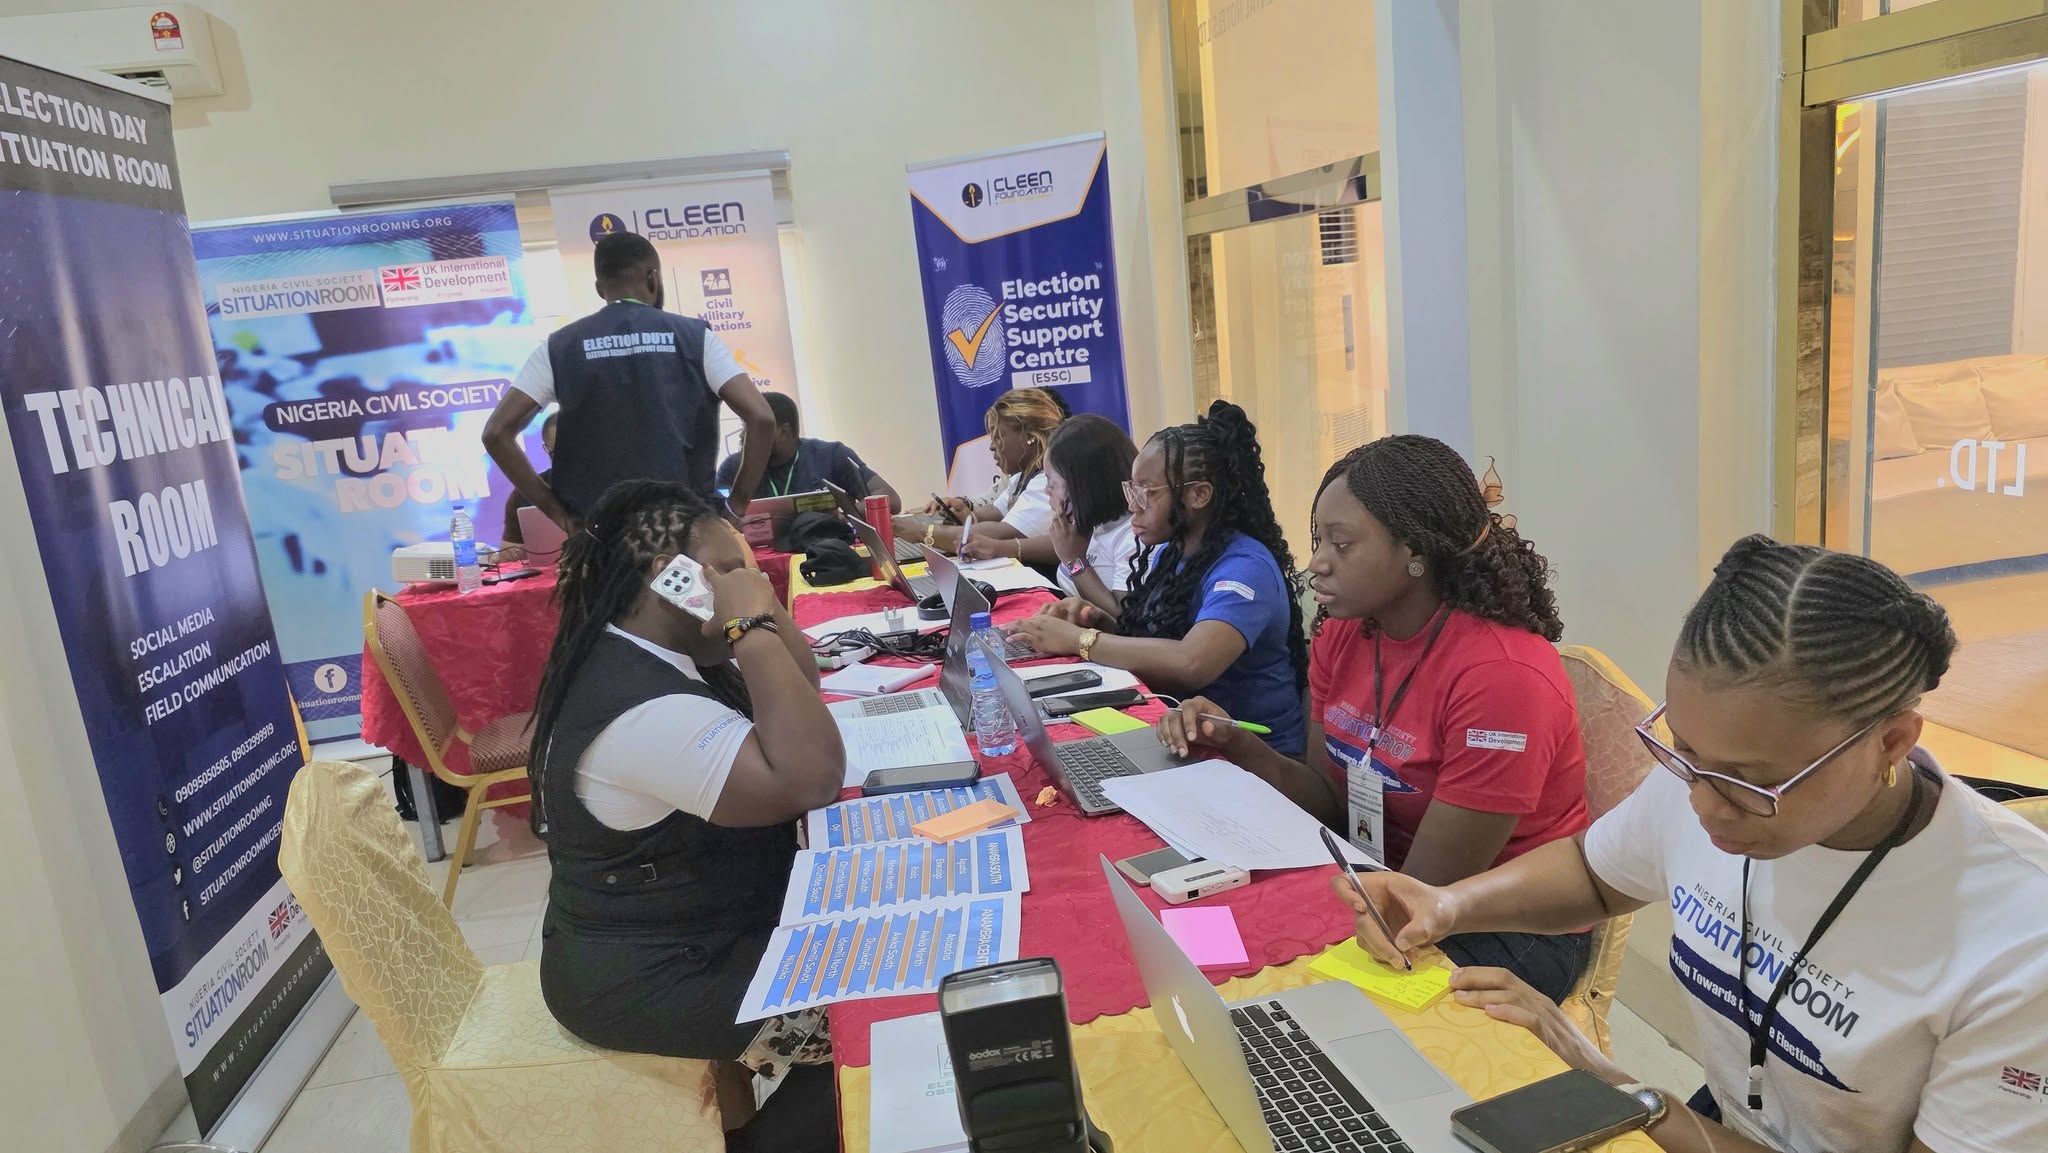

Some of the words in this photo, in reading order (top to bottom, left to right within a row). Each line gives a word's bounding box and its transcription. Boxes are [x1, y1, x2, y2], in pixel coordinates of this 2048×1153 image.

[0, 82, 106, 136] LECTION
[108, 110, 148, 145] DAY
[0, 131, 111, 180] ITUATION
[113, 154, 172, 190] ROOM
[993, 170, 1053, 192] CLEEN
[645, 201, 745, 229] CLEEN
[252, 216, 453, 245] WWW.SITUATIONROOMNG.ORG
[647, 223, 746, 241] FOUNDATION
[422, 264, 439, 275] UK
[440, 259, 506, 273] International
[424, 271, 508, 289] Development
[232, 282, 278, 295] NIGERIA
[282, 278, 312, 290] CIVIL
[316, 274, 364, 287] SOCIETY
[1001, 271, 1100, 300] Election
[222, 284, 377, 315] SITUATIONROOM
[706, 298, 733, 310] Civil
[1004, 294, 1104, 324] Security
[697, 310, 745, 321] Military
[710, 320, 752, 332] lations
[583, 332, 640, 352] ELECTION
[641, 332, 675, 345] DUTY
[1006, 319, 1105, 348] Support
[1009, 347, 1090, 370] Centre
[1031, 369, 1072, 386] (ESSC)
[276, 399, 365, 425] NIGERIA
[365, 393, 418, 415] CIVIL
[418, 383, 505, 409] SOCIETY
[24, 375, 232, 475] TECHNICAL
[335, 462, 491, 513] ROOM
[108, 479, 218, 578] ROOM
[130, 625, 178, 660] SOCIAL
[177, 607, 215, 638] MEDIA
[137, 640, 212, 693] ESCALATION
[145, 691, 183, 726] FIELD
[183, 640, 272, 703] COMMUNICATION
[298, 693, 362, 709] ituationroomn
[175, 755, 233, 804] 09095050505,
[231, 722, 275, 763] 09032999919
[182, 740, 298, 838] WWW.SITUATIONROOMNG.ORG
[192, 795, 273, 874] @SITUATIONROOMNG
[200, 818, 284, 906] SITUATIONROOMNIGER
[1694, 882, 1737, 923] NIGERIA
[1745, 921, 1785, 954] CIVIL
[1789, 951, 1855, 1000] SOCIETY
[189, 979, 216, 1010] NIGERIA
[216, 960, 235, 982] CIVIL
[234, 930, 260, 962] SOCIETY
[827, 958, 842, 979] North
[884, 949, 898, 970] South
[914, 947, 927, 967] North
[800, 962, 816, 985] South
[185, 938, 270, 1049] SITUATIONROOM
[212, 942, 325, 1083] WWW.SITUATIONROOMNG.O
[1670, 950, 1690, 977] rking
[1692, 966, 1737, 1008] Towards
[1776, 1030, 1824, 1076] Elections
